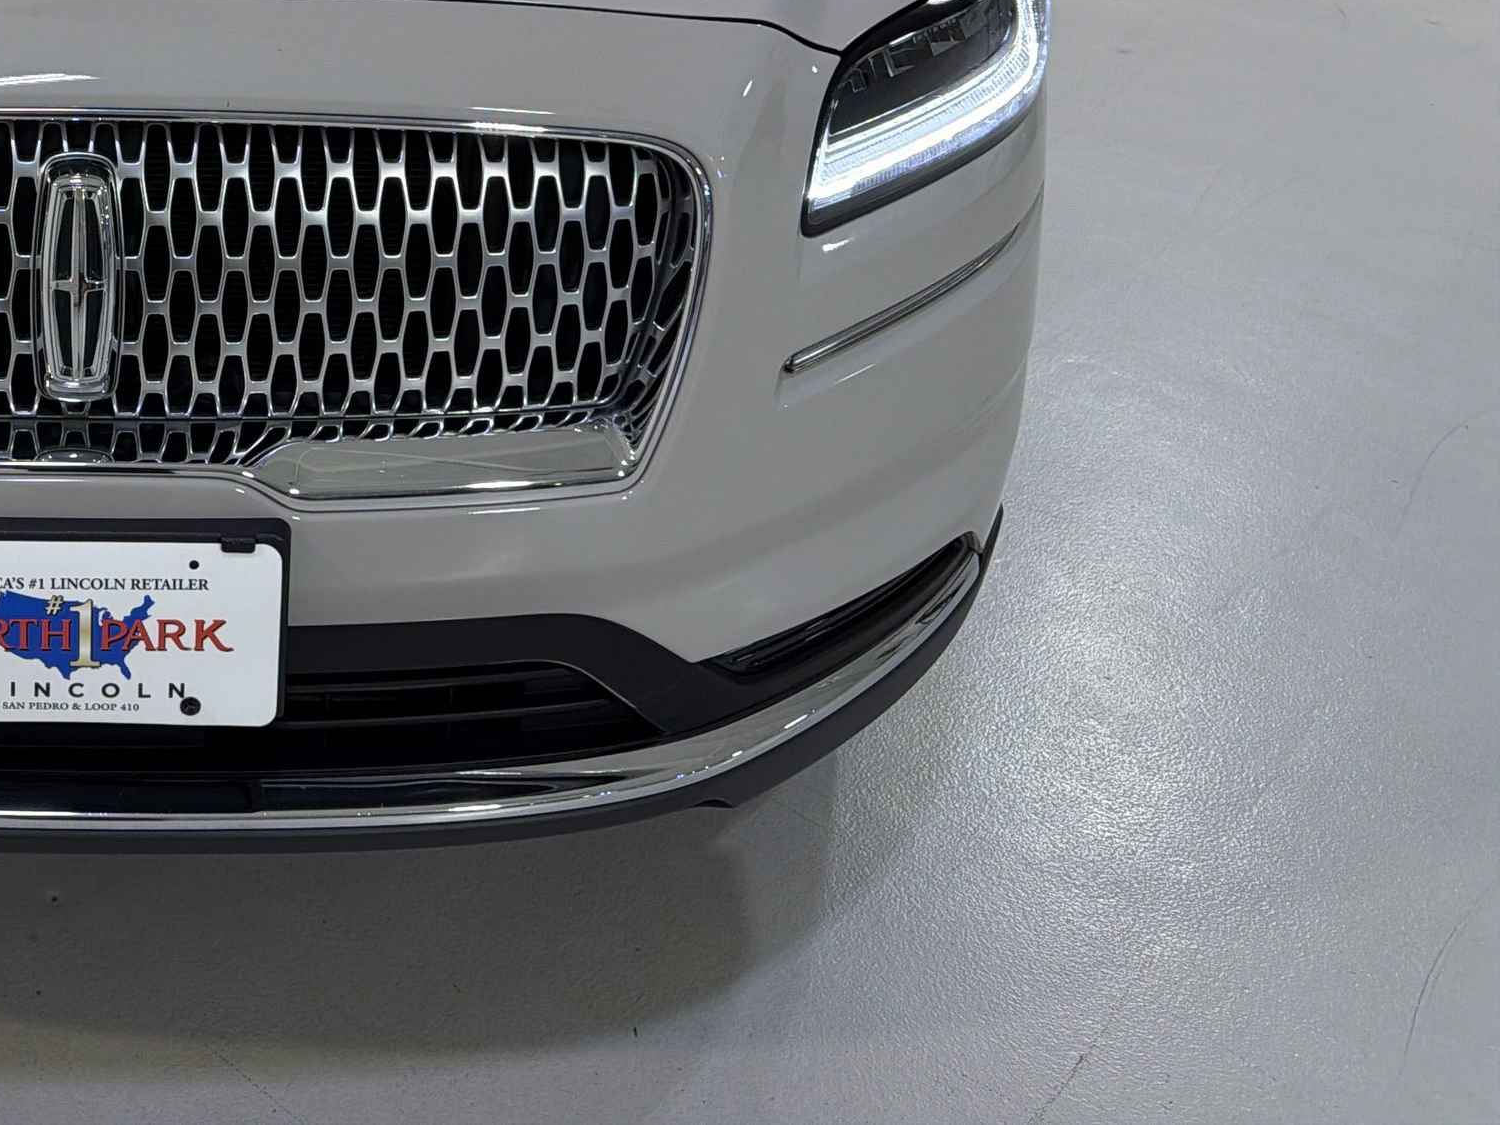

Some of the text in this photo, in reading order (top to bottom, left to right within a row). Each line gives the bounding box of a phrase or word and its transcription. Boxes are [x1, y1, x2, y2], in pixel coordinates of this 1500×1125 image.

[29, 577, 45, 590] #1
[50, 577, 126, 591] LINCOLN
[130, 578, 210, 591] RETAILER
[100, 618, 235, 653] PARK
[2, 701, 140, 712] SAN PEDRO & LOOP 410
